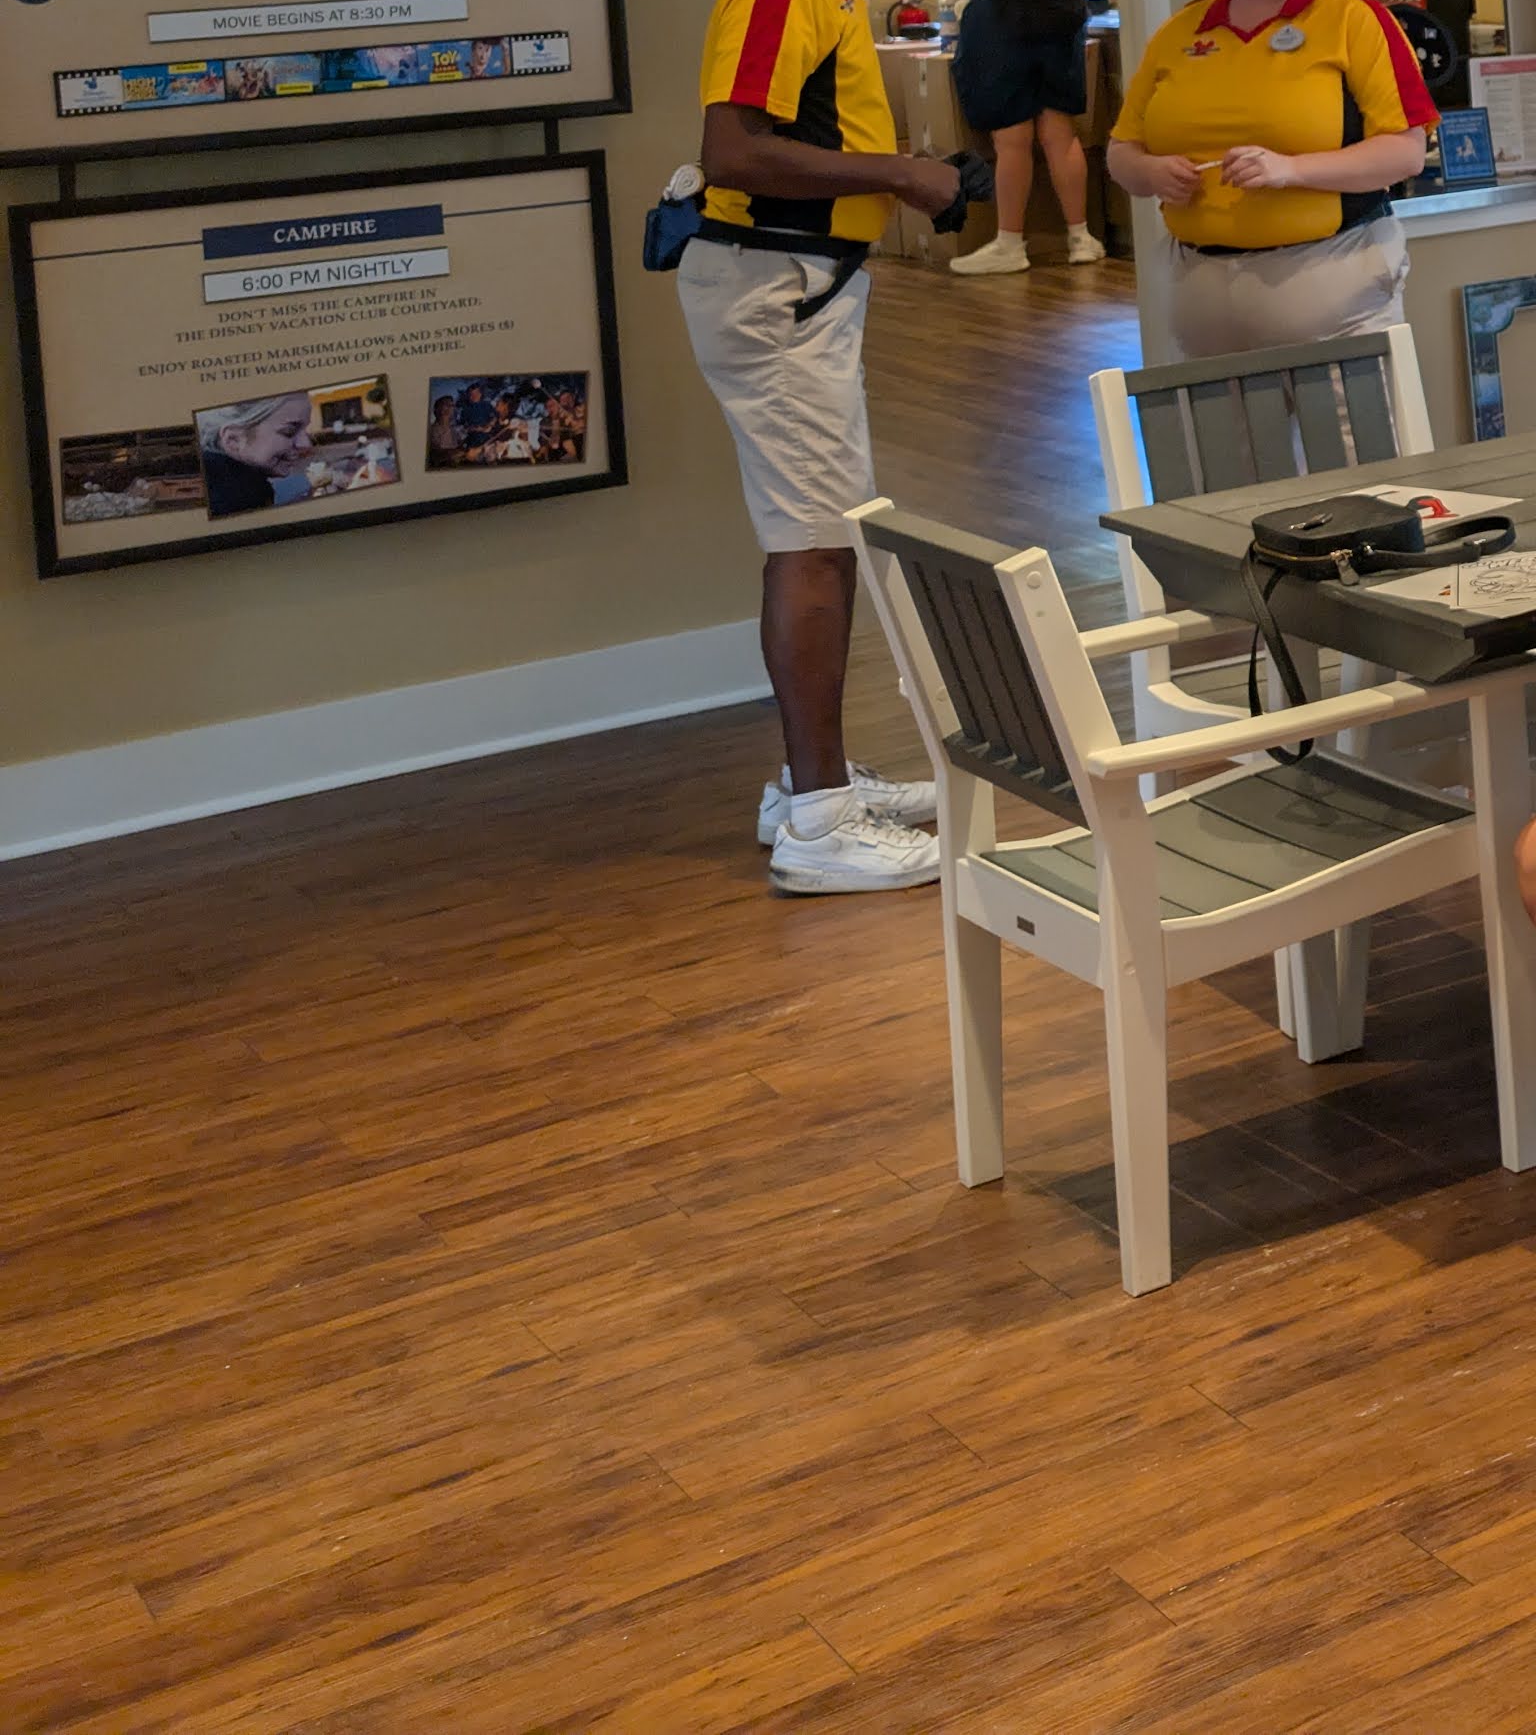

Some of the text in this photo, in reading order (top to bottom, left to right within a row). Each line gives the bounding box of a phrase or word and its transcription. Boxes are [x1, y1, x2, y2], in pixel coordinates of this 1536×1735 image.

[213, 4, 412, 30] MOVIE BEGINS AT 8:30 PM
[431, 50, 458, 66] TOY
[273, 219, 377, 243] CAMPFIRE
[242, 257, 414, 292] 6:00 PM NIGHTLY
[218, 287, 438, 323] DON'T MISS THE CAMPFIRE IN
[176, 329, 207, 343] THE
[210, 323, 265, 339] DISNEY
[269, 312, 345, 331] VACATION
[350, 307, 388, 321] CLUB
[139, 360, 189, 377] ENJOY
[191, 351, 263, 370] ROASTED
[267, 333, 395, 360] MARSHMALLOWS
[400, 329, 432, 342] AND
[434, 320, 495, 338] S'MORES
[200, 372, 217, 383] IN
[223, 367, 250, 381] THE
[255, 360, 302, 376] WARM
[306, 354, 350, 369] GLOW
[354, 351, 373, 363] OF
[377, 349, 386, 360] A
